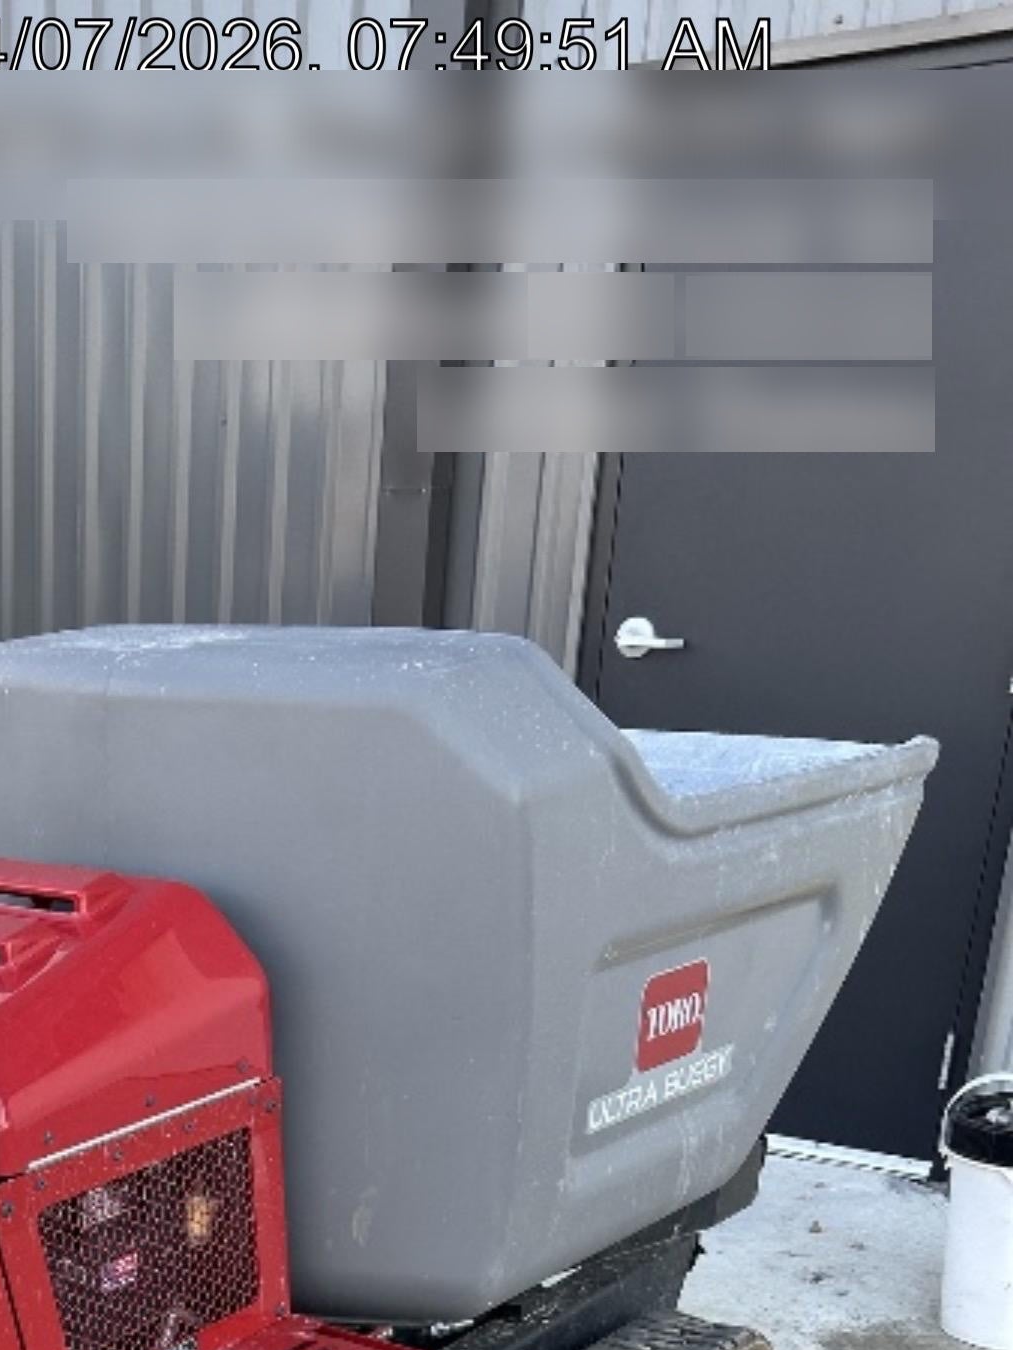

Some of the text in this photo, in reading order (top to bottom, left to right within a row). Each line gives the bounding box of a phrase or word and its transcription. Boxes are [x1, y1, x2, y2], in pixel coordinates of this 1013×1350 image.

[646, 991, 704, 1042] TORO
[587, 1043, 735, 1135] ULTRA BUGGY
